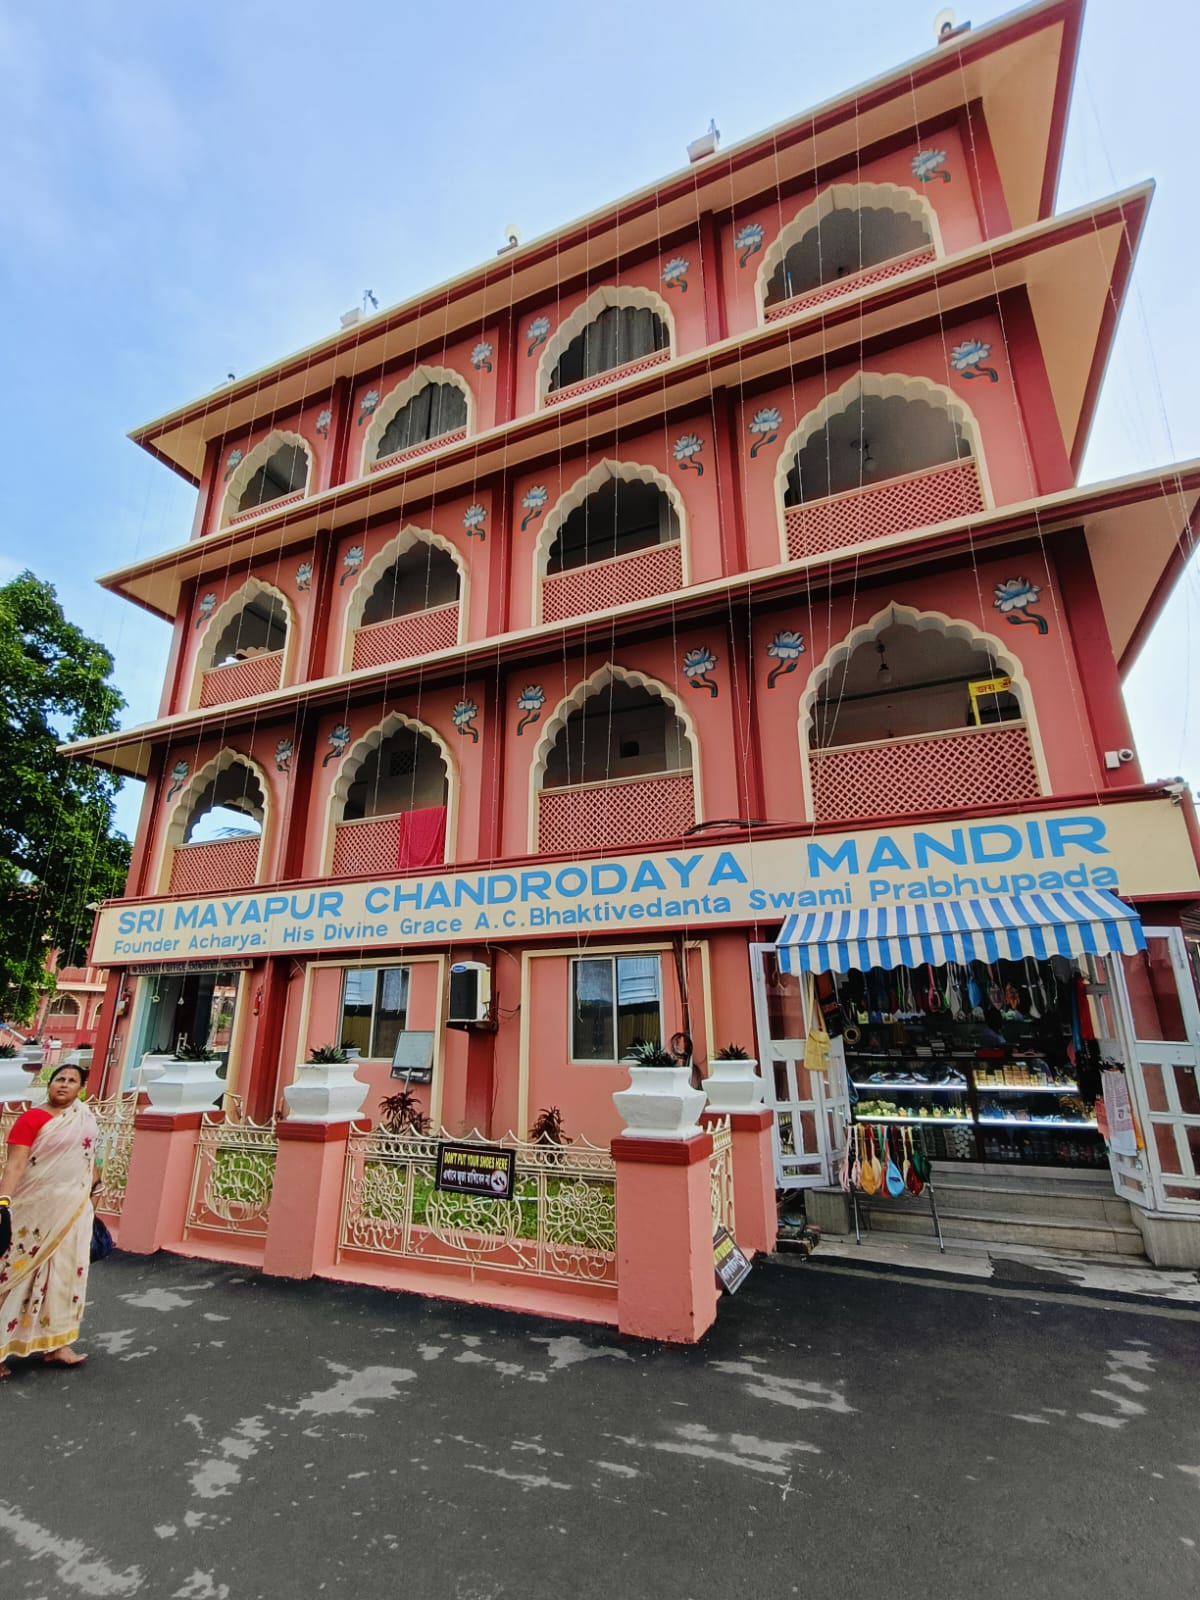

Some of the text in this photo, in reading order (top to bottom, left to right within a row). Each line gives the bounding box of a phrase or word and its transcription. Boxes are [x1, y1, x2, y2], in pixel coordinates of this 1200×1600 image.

[113, 936, 181, 956] Founder
[283, 926, 315, 945] His
[324, 922, 389, 940] Divine
[400, 916, 463, 936] Grace
[748, 880, 853, 911] Swami
[868, 863, 1120, 903] Prabhupada
[117, 815, 1111, 936] SRI MAYAPUR CHANDRODAYA MANDIR
[458, 1153, 467, 1166] PUT
[480, 1155, 495, 1169] SHOES
[495, 1157, 508, 1171] HERE
